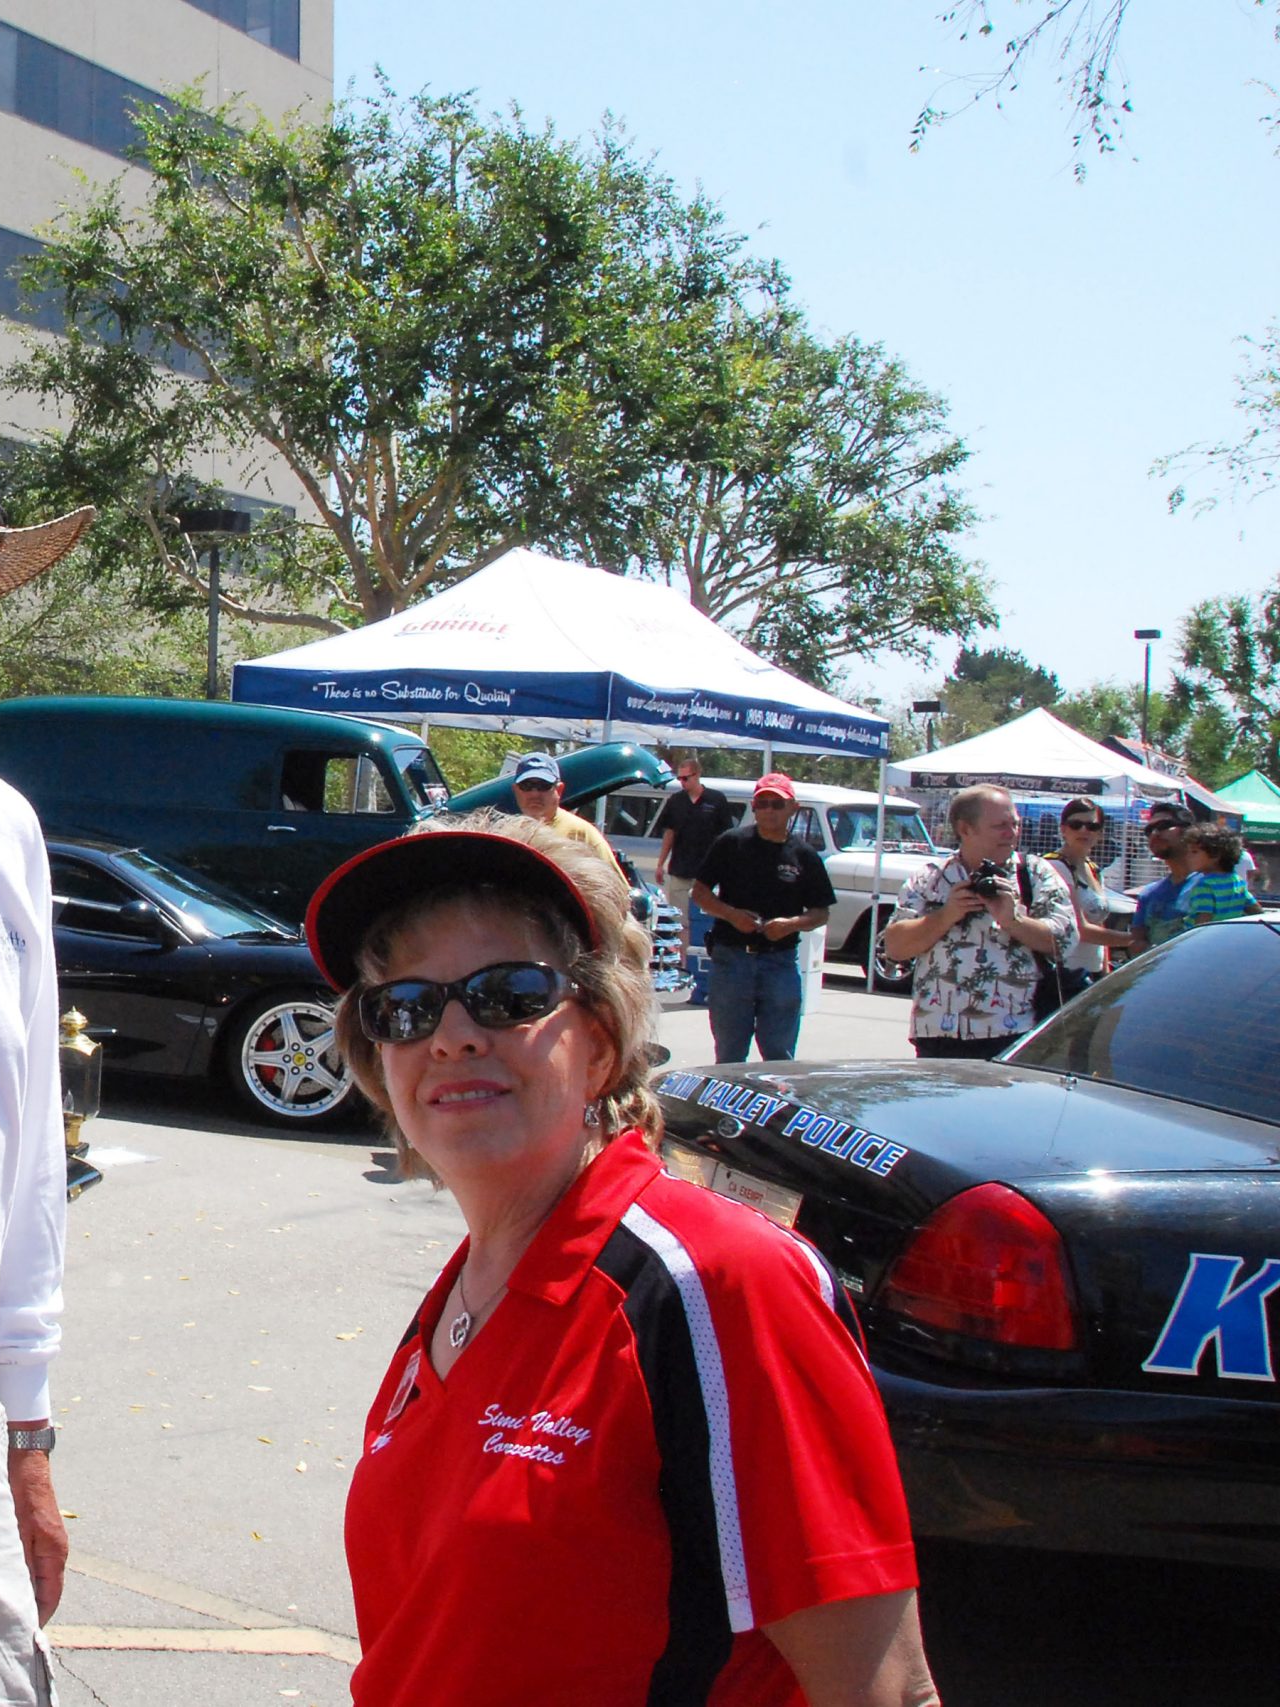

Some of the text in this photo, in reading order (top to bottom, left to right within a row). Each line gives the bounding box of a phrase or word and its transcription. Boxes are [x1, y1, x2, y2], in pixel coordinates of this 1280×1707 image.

[352, 687, 362, 699] is
[365, 689, 377, 698] no
[381, 680, 443, 700] Substitute
[445, 686, 461, 700] for
[696, 1078, 789, 1127] VALLEY
[782, 1107, 909, 1178] POLICE
[477, 1403, 592, 1446] Simi Valley
[482, 1432, 565, 1465] Corvettes
